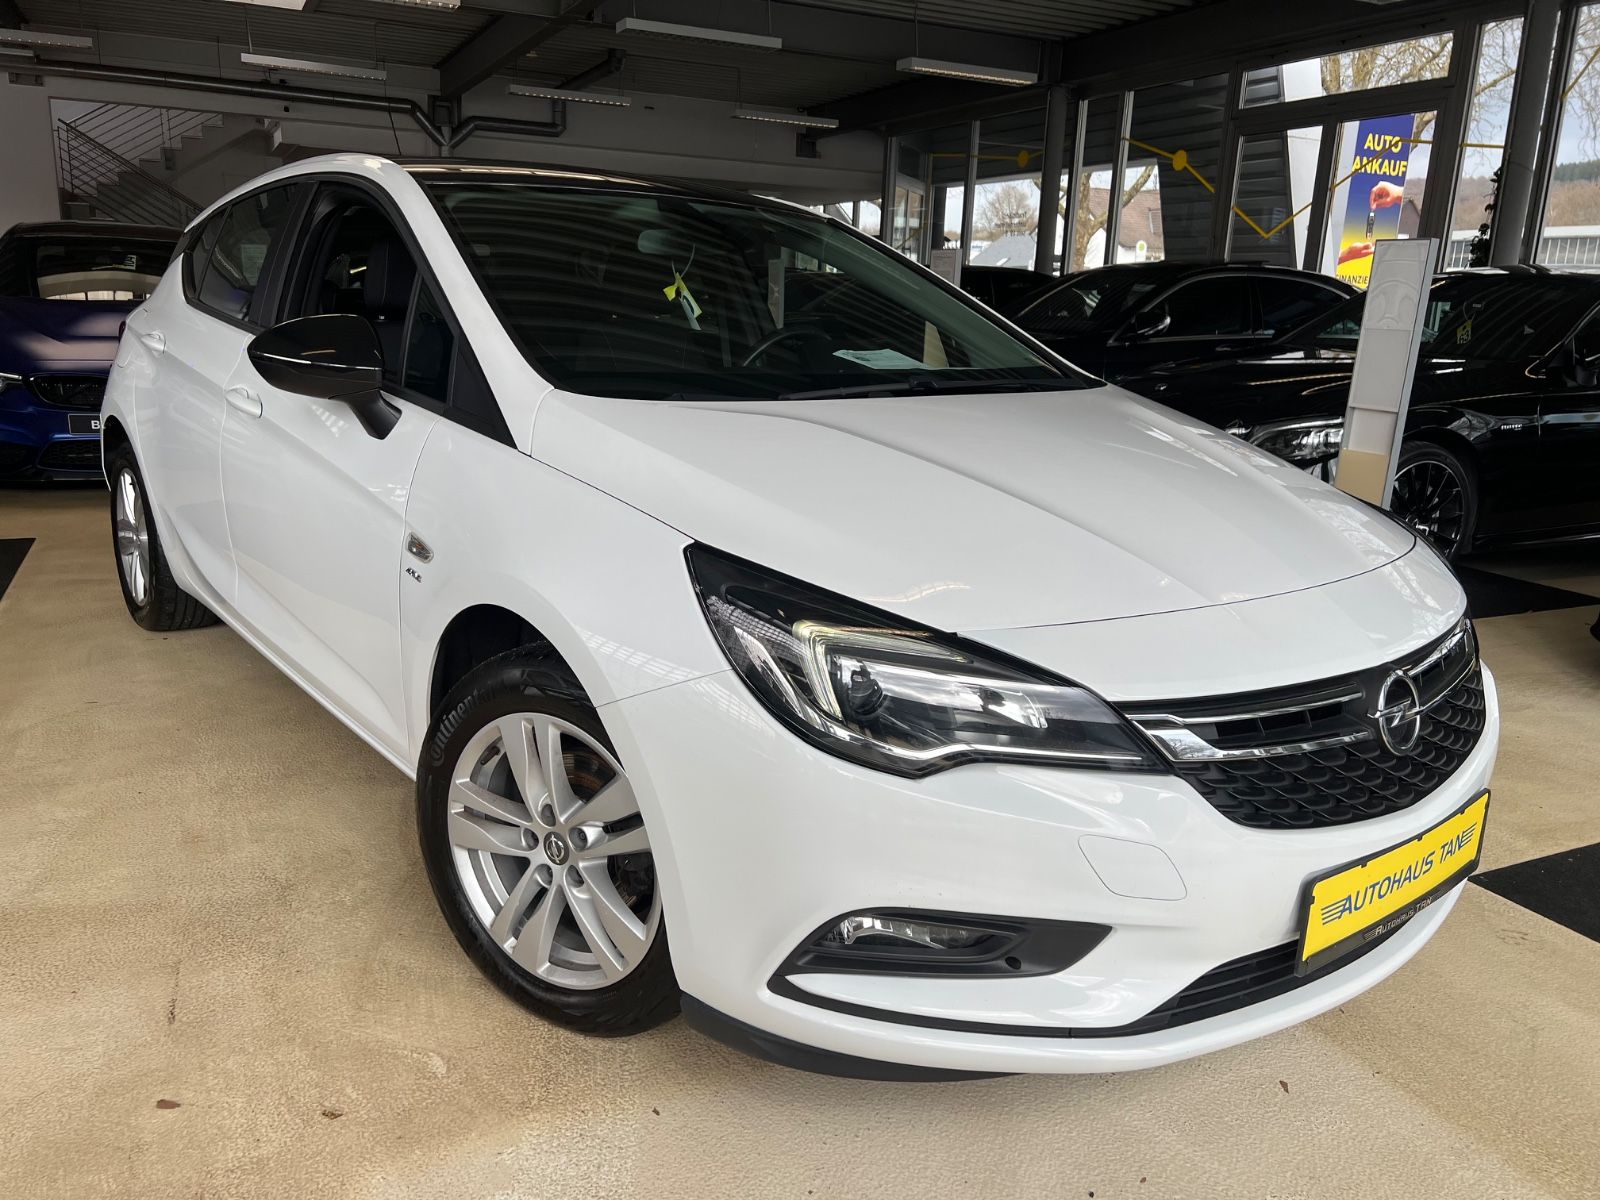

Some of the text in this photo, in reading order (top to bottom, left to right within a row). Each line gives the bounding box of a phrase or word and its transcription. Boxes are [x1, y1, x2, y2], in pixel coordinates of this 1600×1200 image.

[1364, 133, 1402, 153] AUTO
[1352, 156, 1408, 176] ANKAUF
[1336, 273, 1369, 285] INANZIE
[1338, 851, 1436, 919] AUTOHAUS
